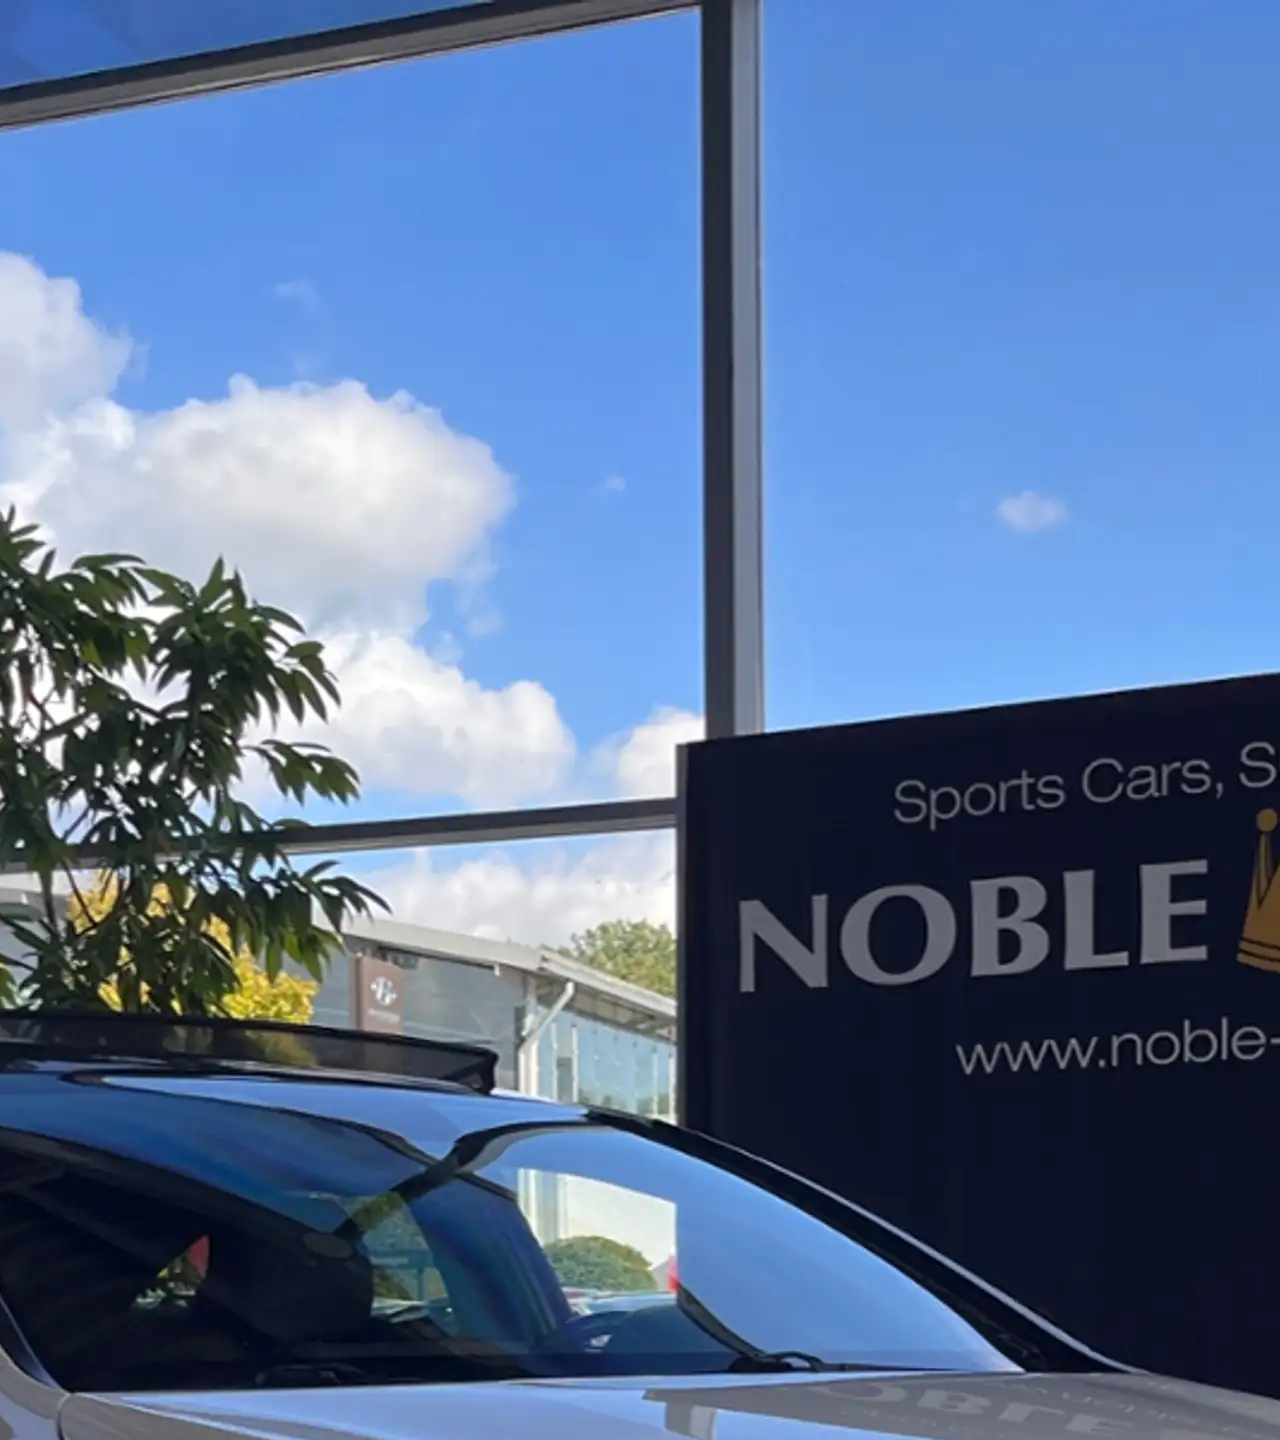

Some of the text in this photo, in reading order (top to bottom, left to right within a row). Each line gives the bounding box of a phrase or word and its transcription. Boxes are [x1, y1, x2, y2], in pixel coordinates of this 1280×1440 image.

[893, 769, 1066, 831] Sports
[1081, 757, 1224, 803] Cars,
[738, 859, 1210, 993] NOBLE
